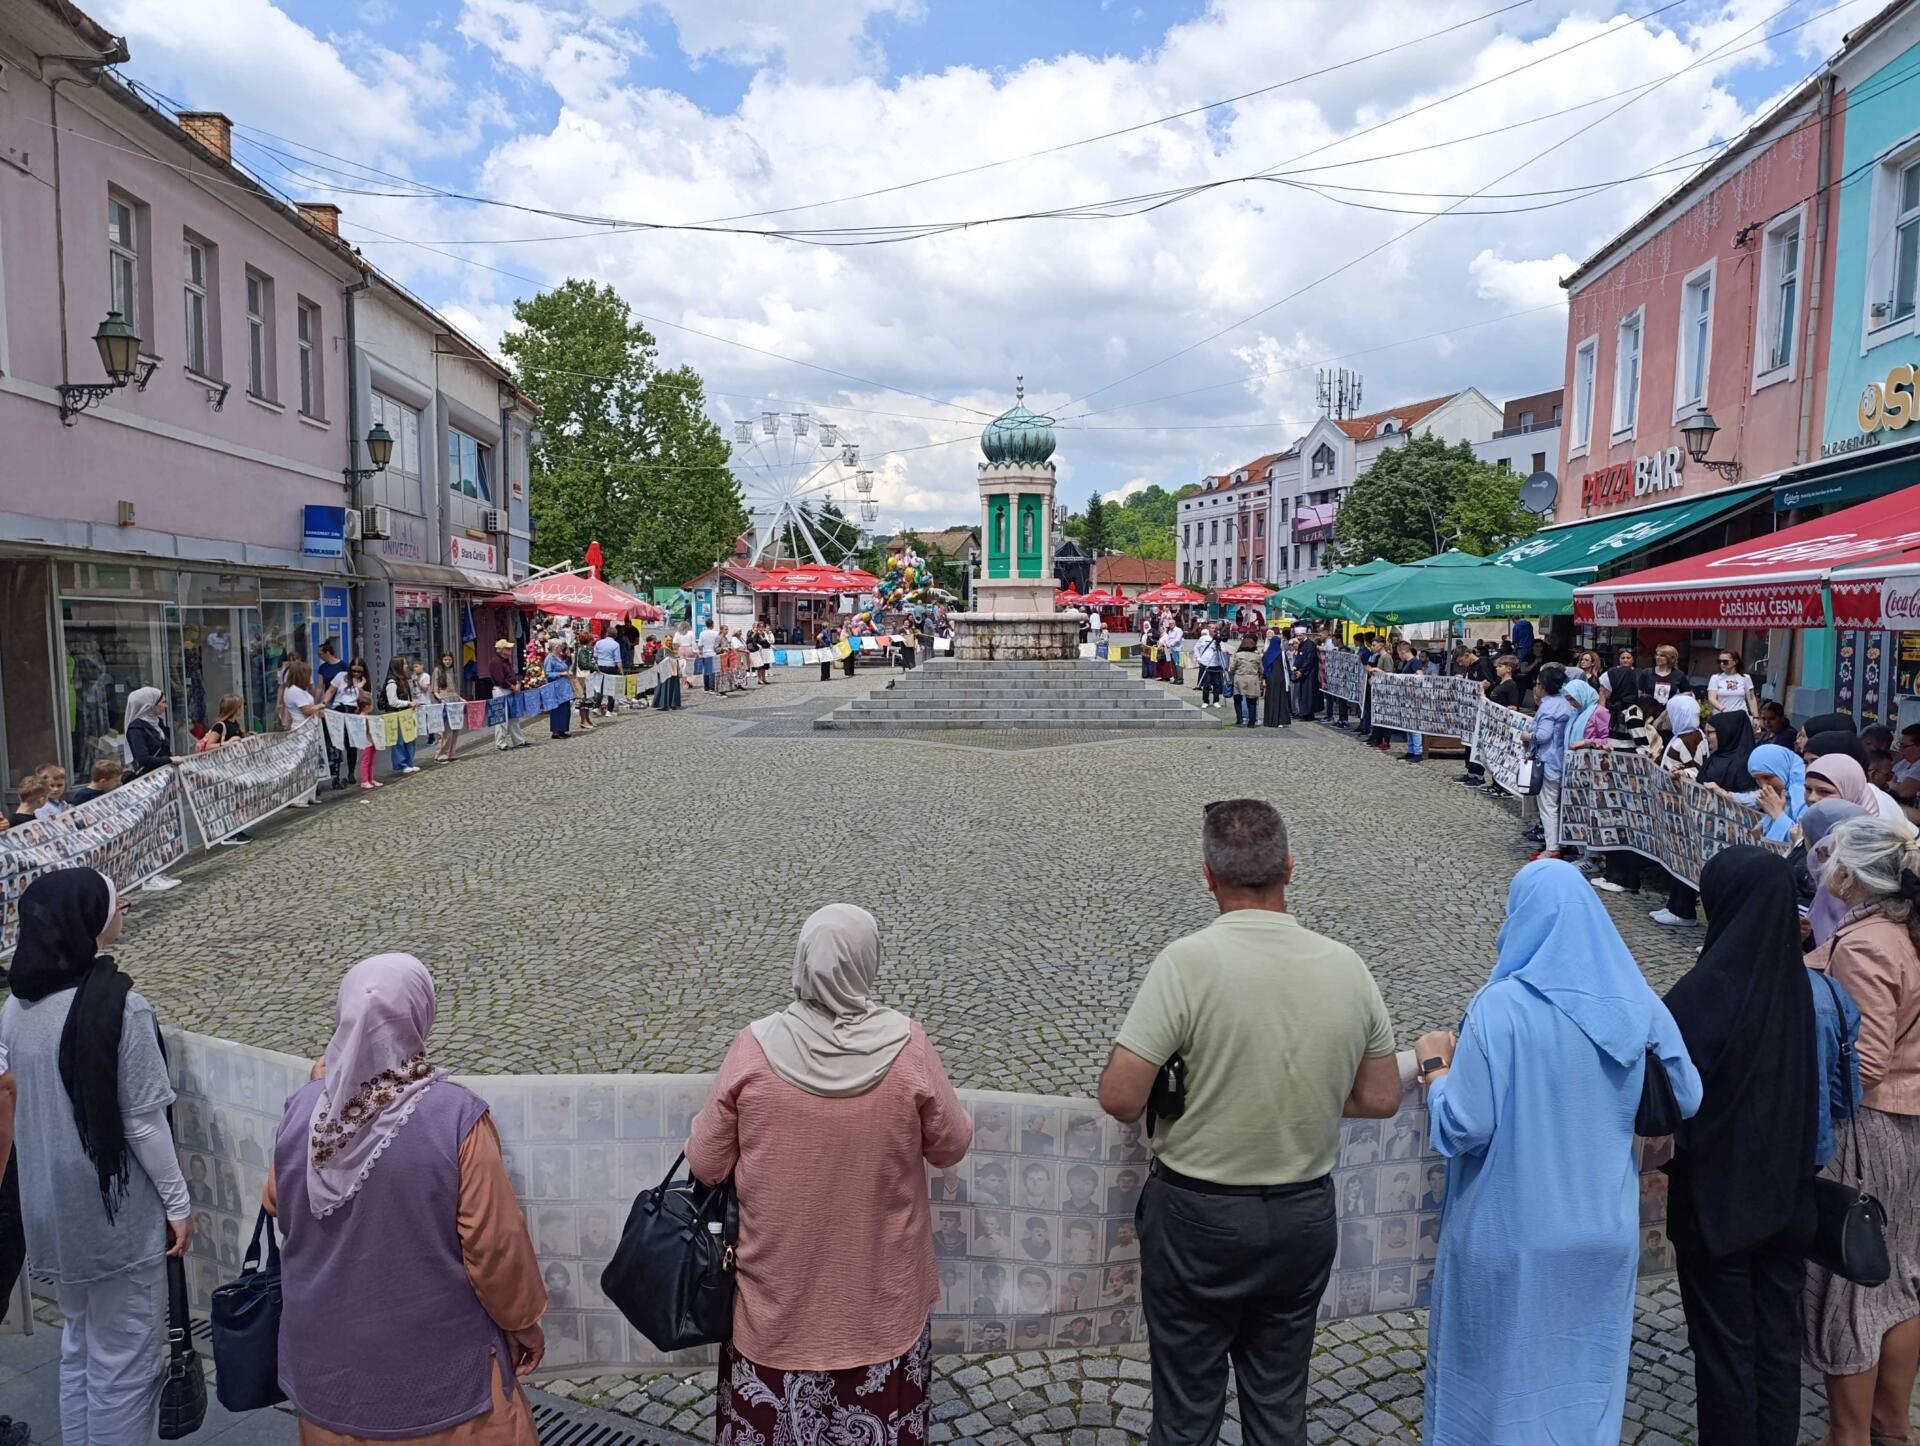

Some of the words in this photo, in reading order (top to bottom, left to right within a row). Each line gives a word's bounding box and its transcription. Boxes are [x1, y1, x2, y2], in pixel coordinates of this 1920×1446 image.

[1820, 434, 1879, 457] PIZZERIA
[1634, 446, 1682, 497] BAR
[382, 540, 421, 560] UNIVERZAL
[1452, 602, 1491, 617] Carlsberg
[1720, 599, 1767, 616] ČARŠIJSKA
[1769, 596, 1803, 615] ČESMA
